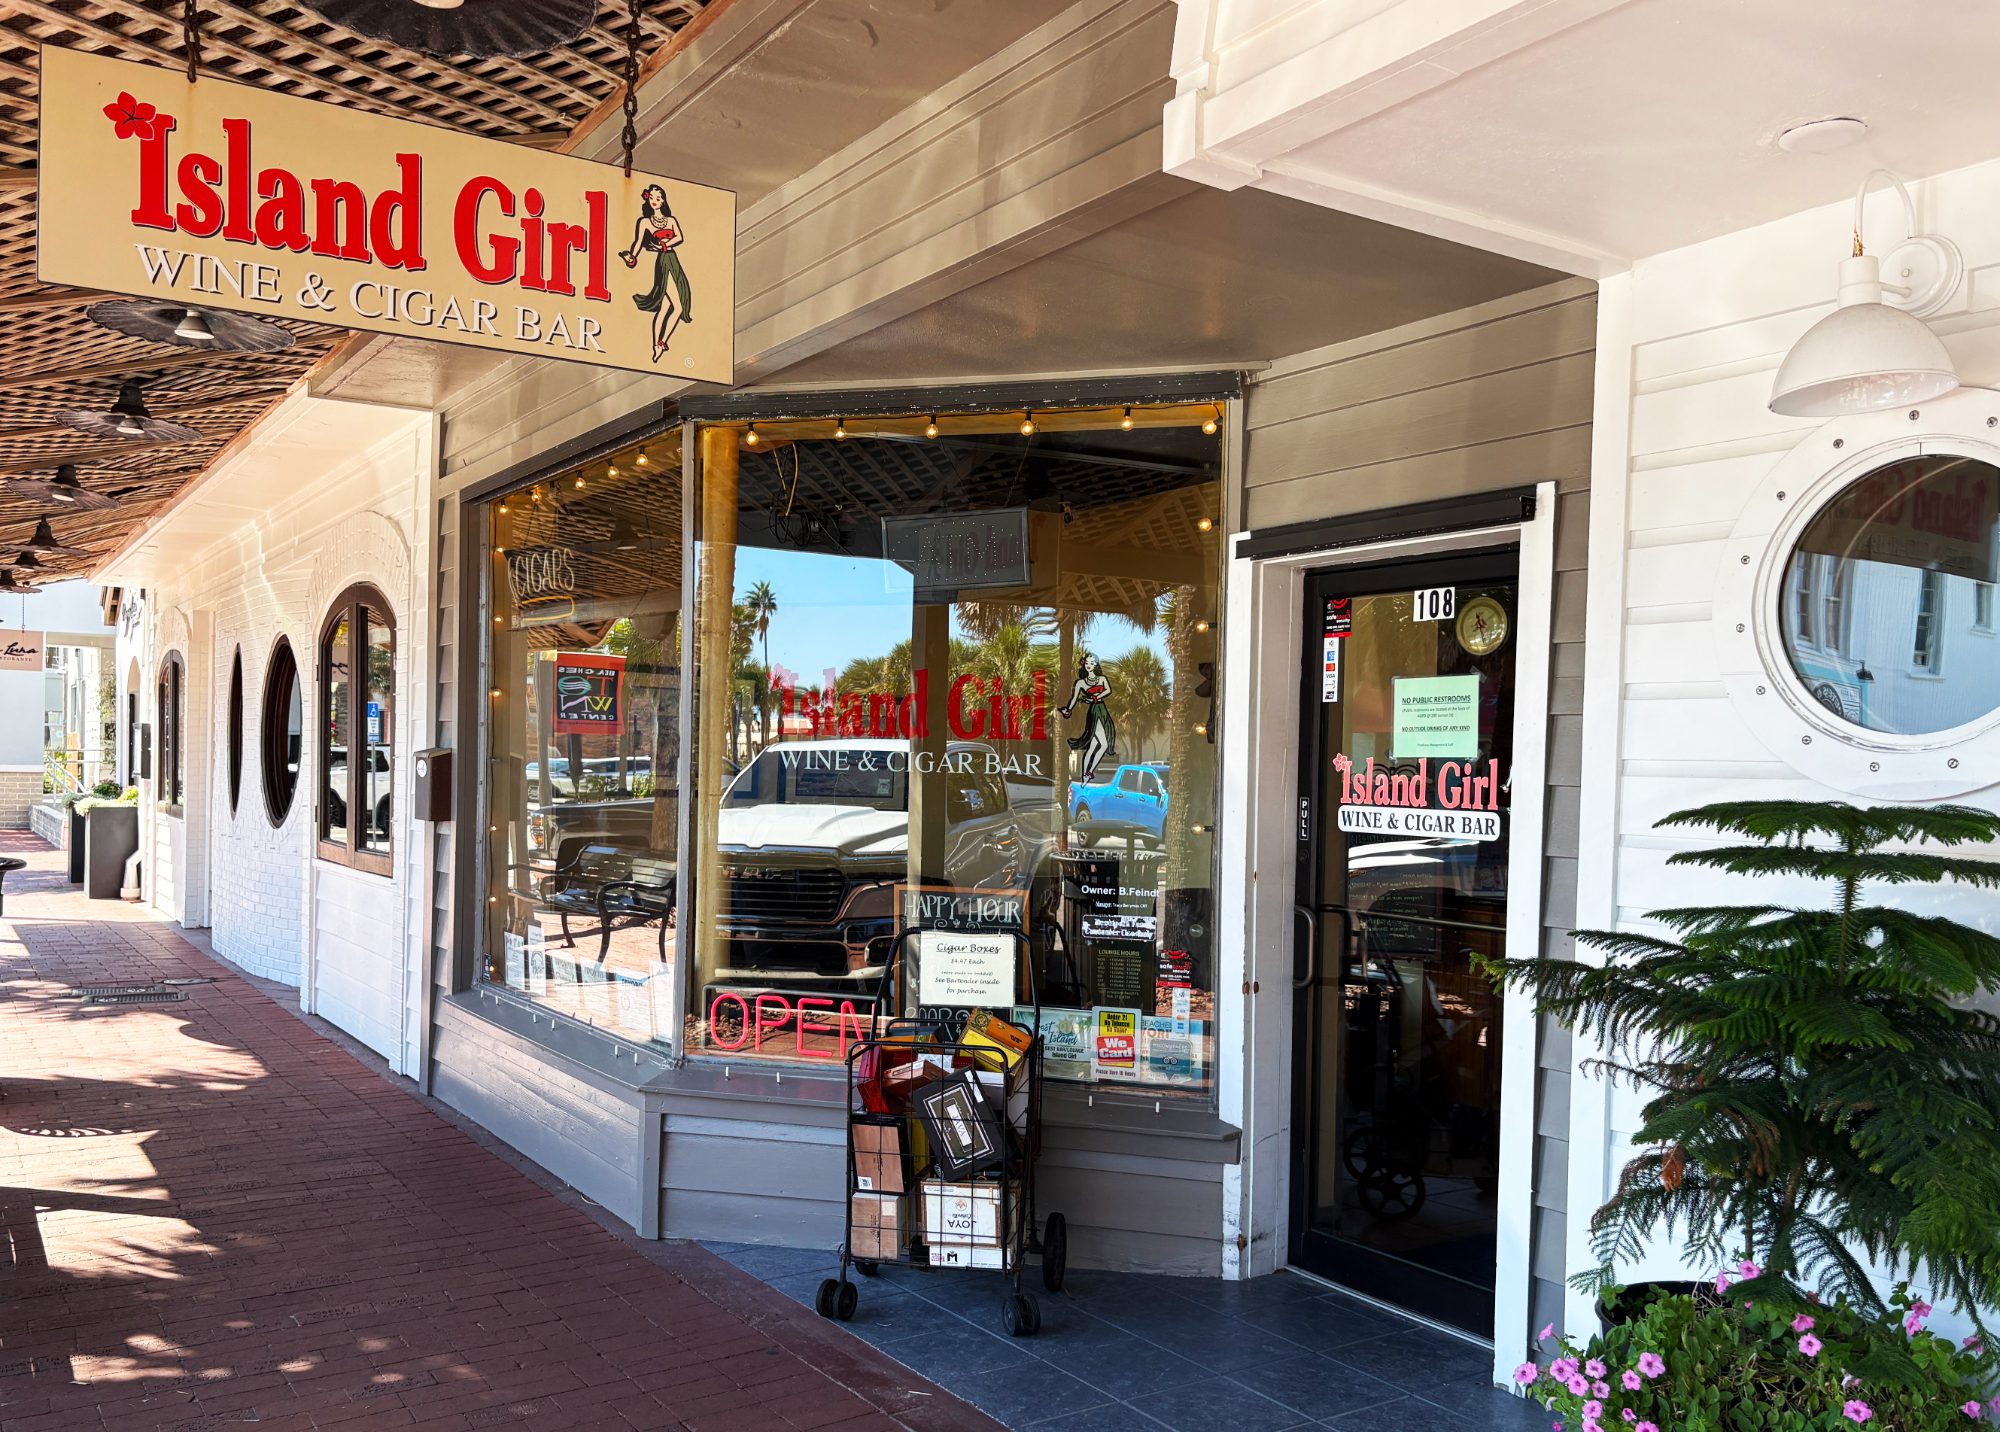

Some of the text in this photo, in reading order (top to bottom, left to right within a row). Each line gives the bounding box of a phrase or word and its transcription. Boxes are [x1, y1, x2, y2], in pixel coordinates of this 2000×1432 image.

[130, 114, 612, 302] Island Girl
[134, 243, 607, 353] WINE & CIGAR BAR
[516, 548, 575, 596] CIGARS
[1418, 588, 1453, 620] 108
[777, 666, 1047, 741] Island Girl
[1412, 696, 1433, 704] PUBLIC
[1433, 695, 1471, 703] RESTROOMS
[781, 750, 1043, 776] WINE & CIGAR BAR
[1340, 756, 1499, 811] Island Girl
[1301, 800, 1309, 838] PULL
[1341, 810, 1496, 836] WINE & CIGAR BAR
[1081, 885, 1160, 898] Owner: B.Feindt
[903, 893, 1022, 924] HAPPY HOUR
[936, 942, 1001, 954] Cigar Boxes
[946, 977, 978, 985] Bartender
[946, 987, 955, 995] for
[711, 992, 876, 1058] OPEN
[1106, 1013, 1121, 1021] Under
[1039, 1021, 1055, 1034] est
[1048, 1031, 1078, 1046] Island
[1104, 1037, 1127, 1049] We
[1067, 1052, 1077, 1060] Girl
[1098, 1047, 1133, 1058] Card
[952, 1115, 967, 1137] JAVA
[947, 1219, 977, 1229] JOYA
